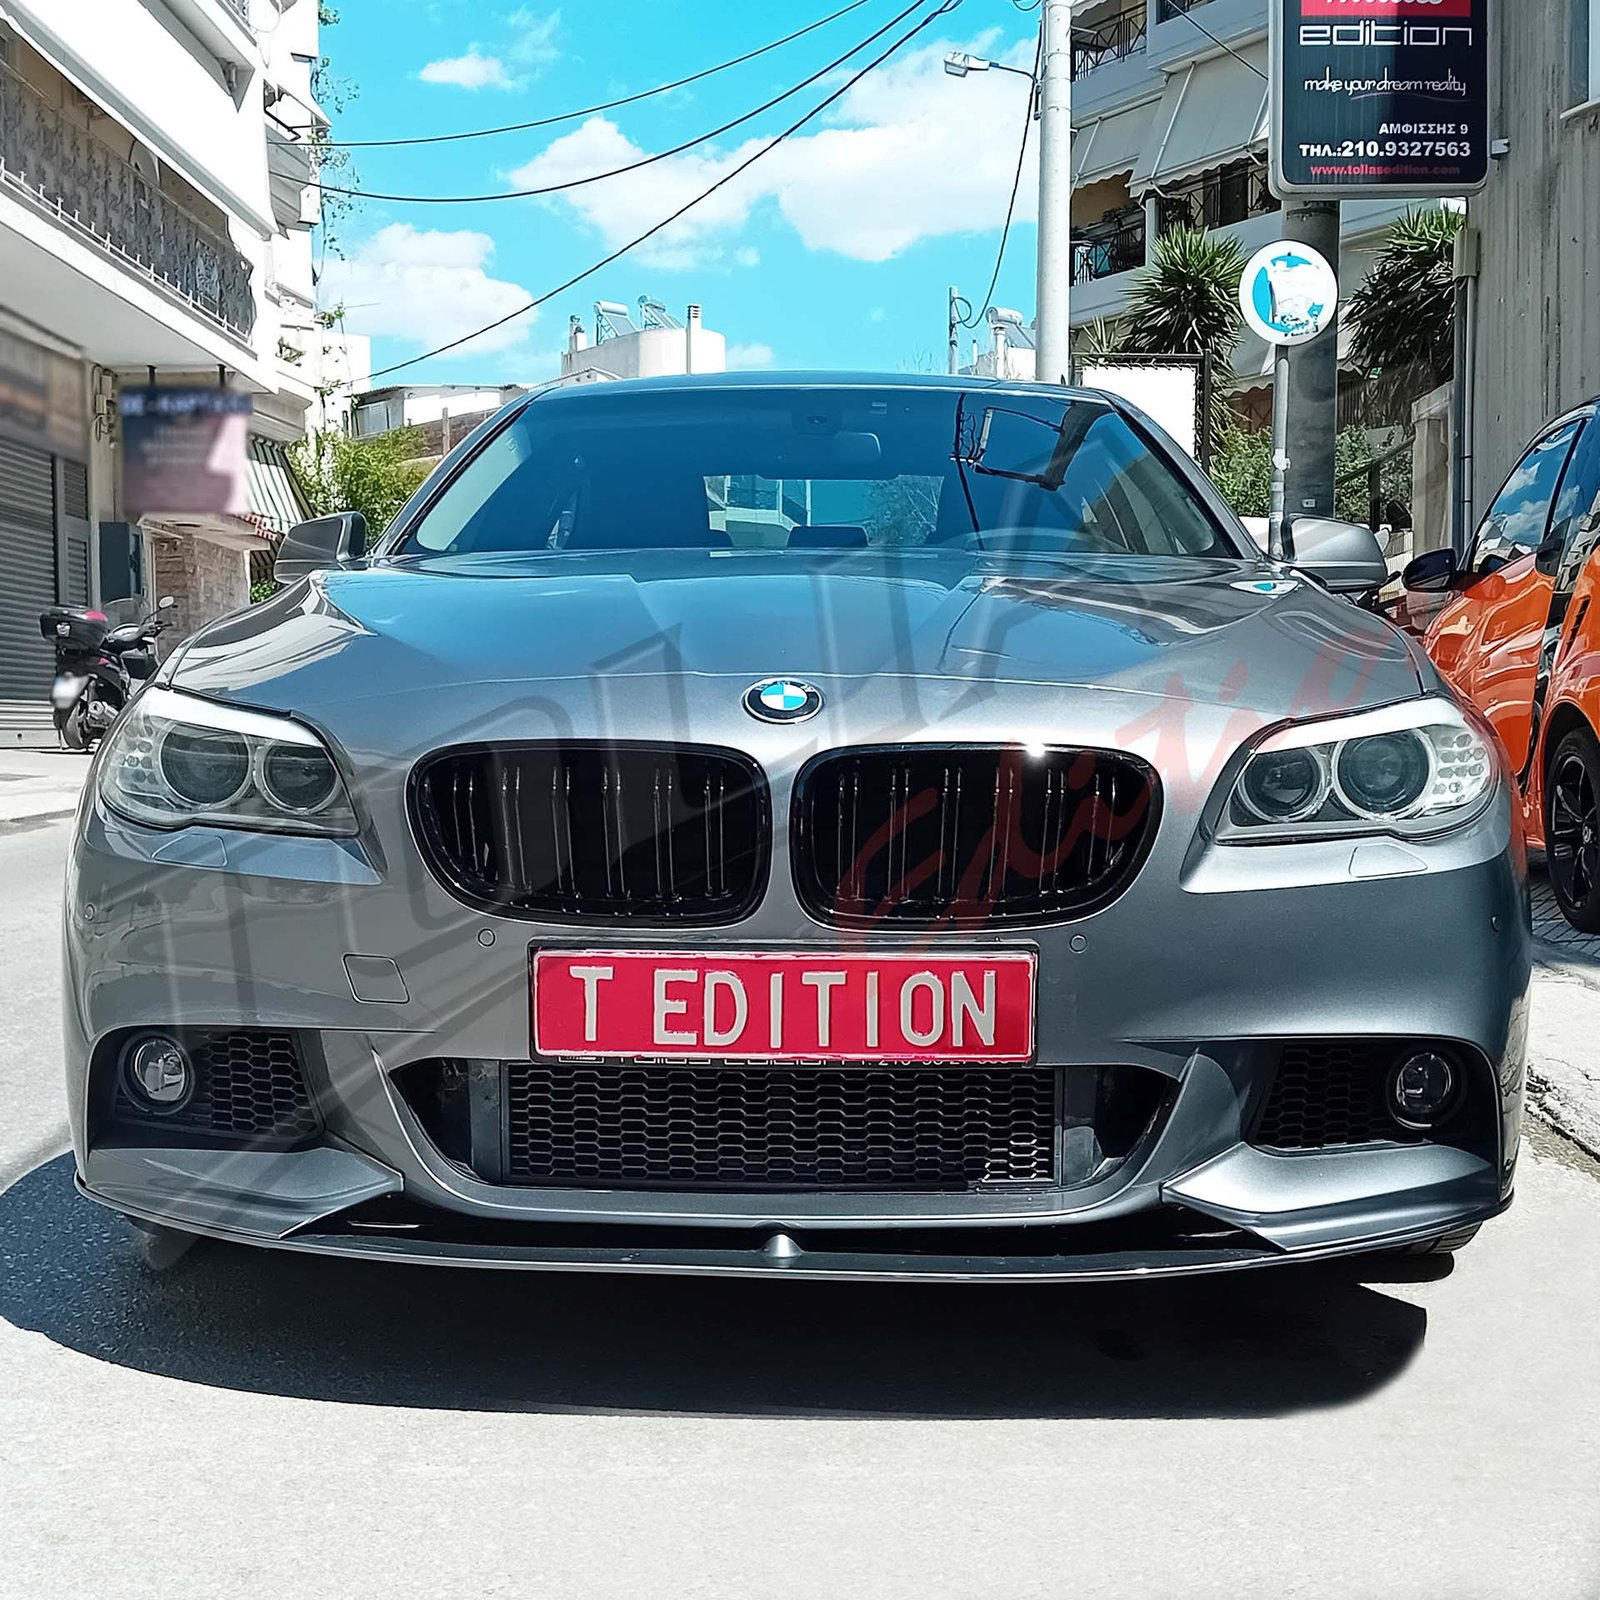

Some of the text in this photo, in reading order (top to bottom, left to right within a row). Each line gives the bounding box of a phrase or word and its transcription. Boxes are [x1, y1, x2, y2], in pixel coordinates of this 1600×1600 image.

[1299, 20, 1472, 46] edition
[1304, 66, 1467, 96] make your dream reality
[1378, 123, 1468, 135] ΑΜΦΙΣΣΗΣ 9
[1310, 164, 1460, 175] www.tollasedition.com
[568, 965, 996, 1048] T EDITION
